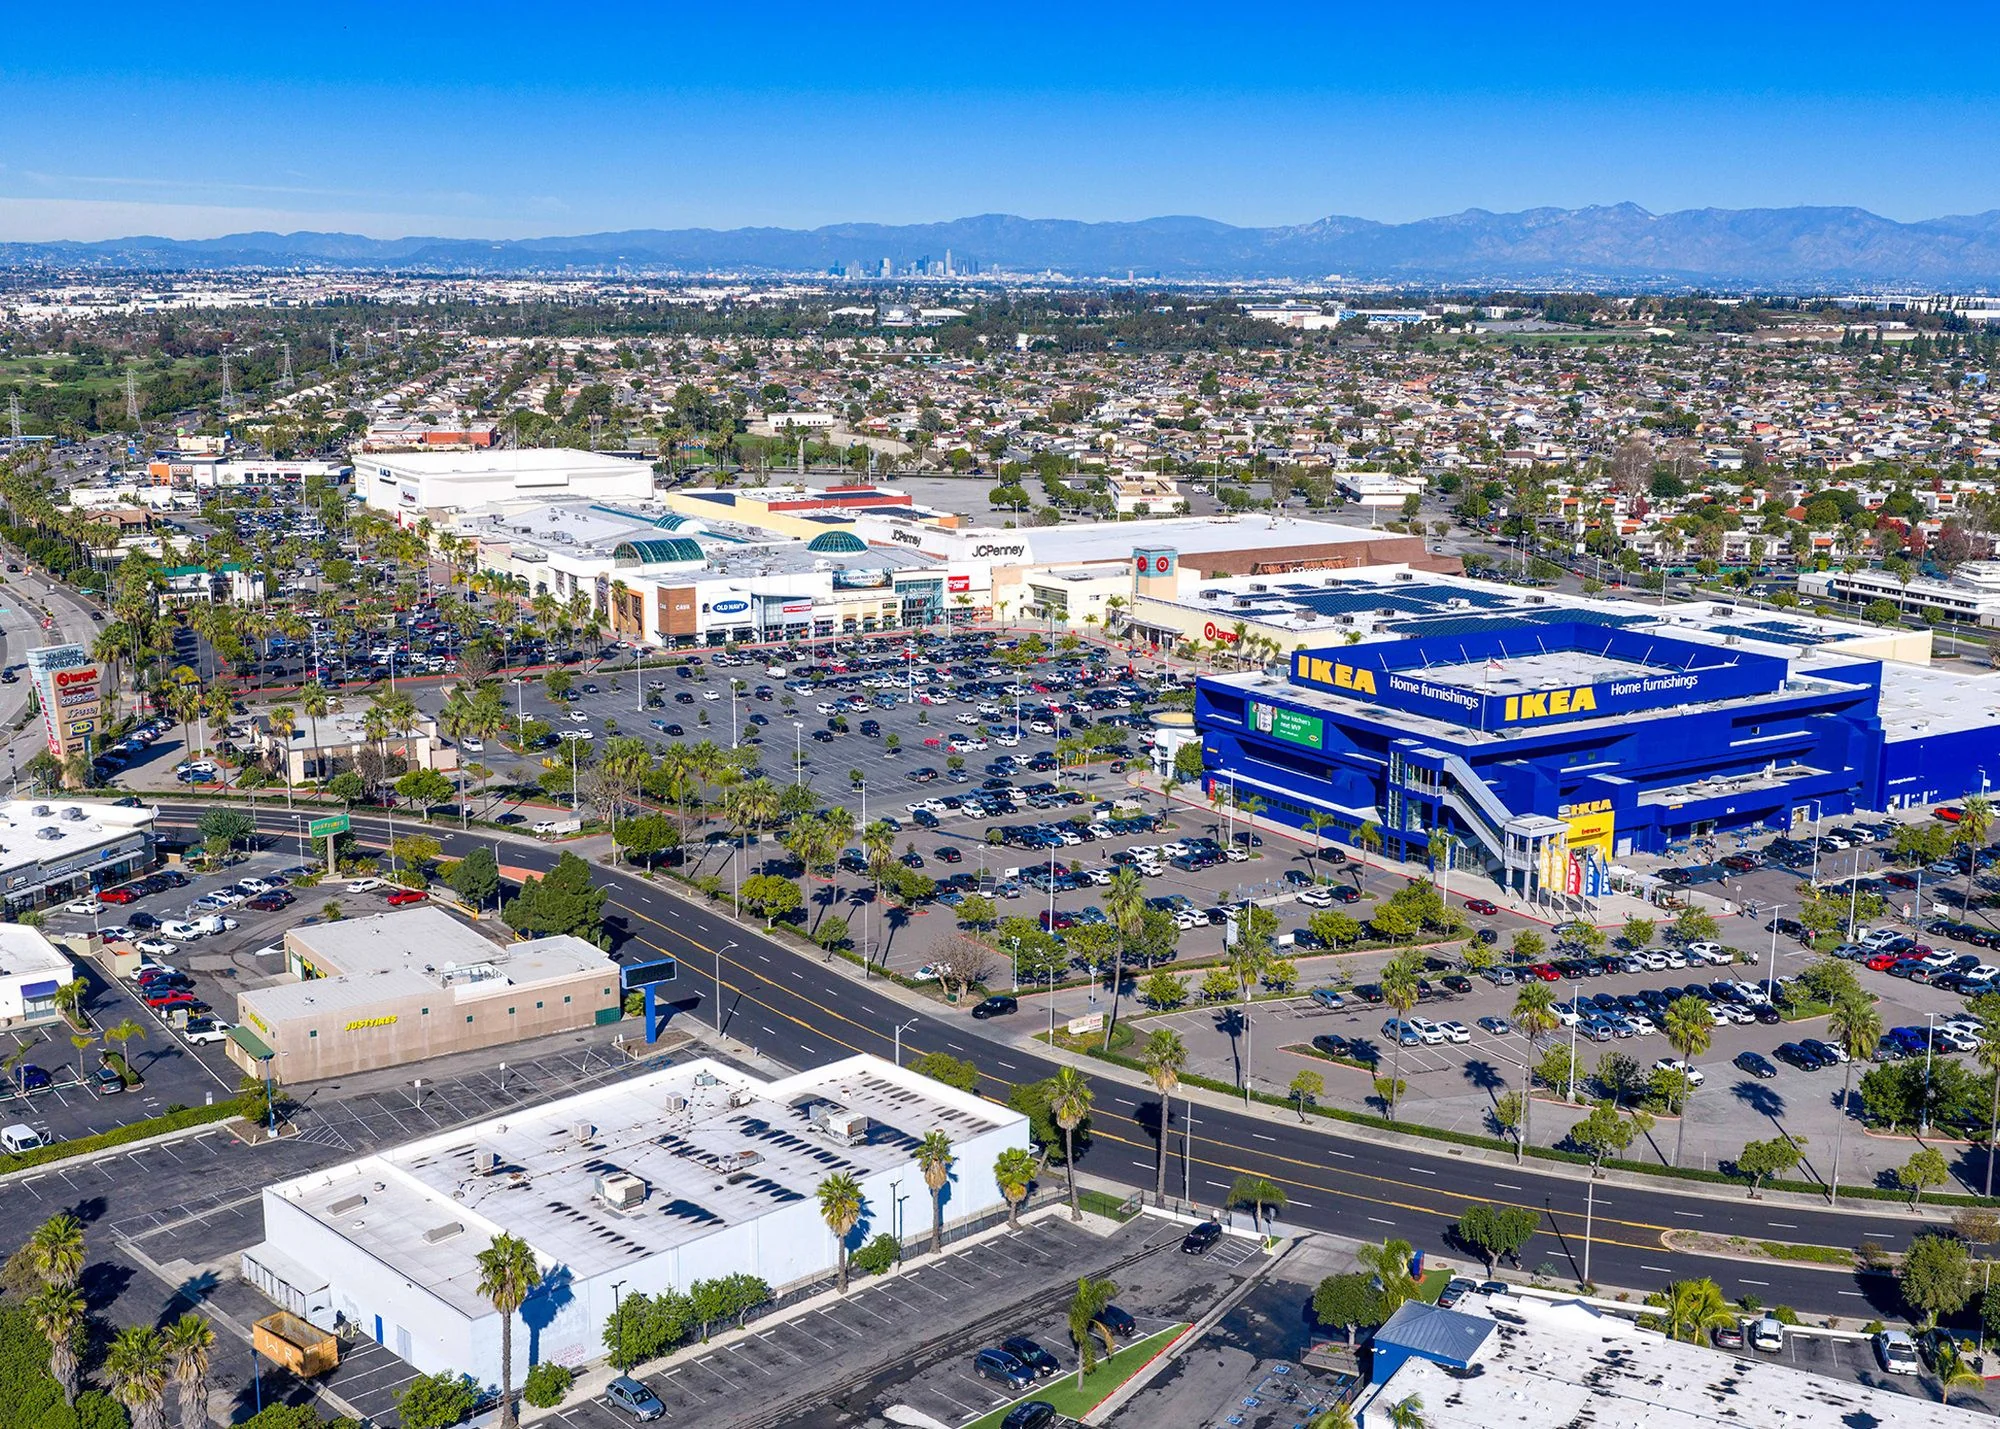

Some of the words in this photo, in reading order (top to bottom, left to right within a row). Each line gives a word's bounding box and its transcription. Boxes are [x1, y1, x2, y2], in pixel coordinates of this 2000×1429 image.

[891, 529, 921, 547] JCPenney
[972, 545, 1024, 557] JCPenney
[729, 603, 745, 611] NAVY
[1216, 628, 1239, 644] targe
[69, 668, 98, 682] target
[1298, 655, 1377, 695] IKEA
[1389, 676, 1419, 694] Home
[1420, 682, 1479, 710] furnishings
[1611, 682, 1641, 696] Home
[1642, 674, 1698, 692] furnishings
[1504, 687, 1597, 721] IKEA
[1571, 799, 1612, 816] IKEA
[1581, 827, 1601, 835] Entrance
